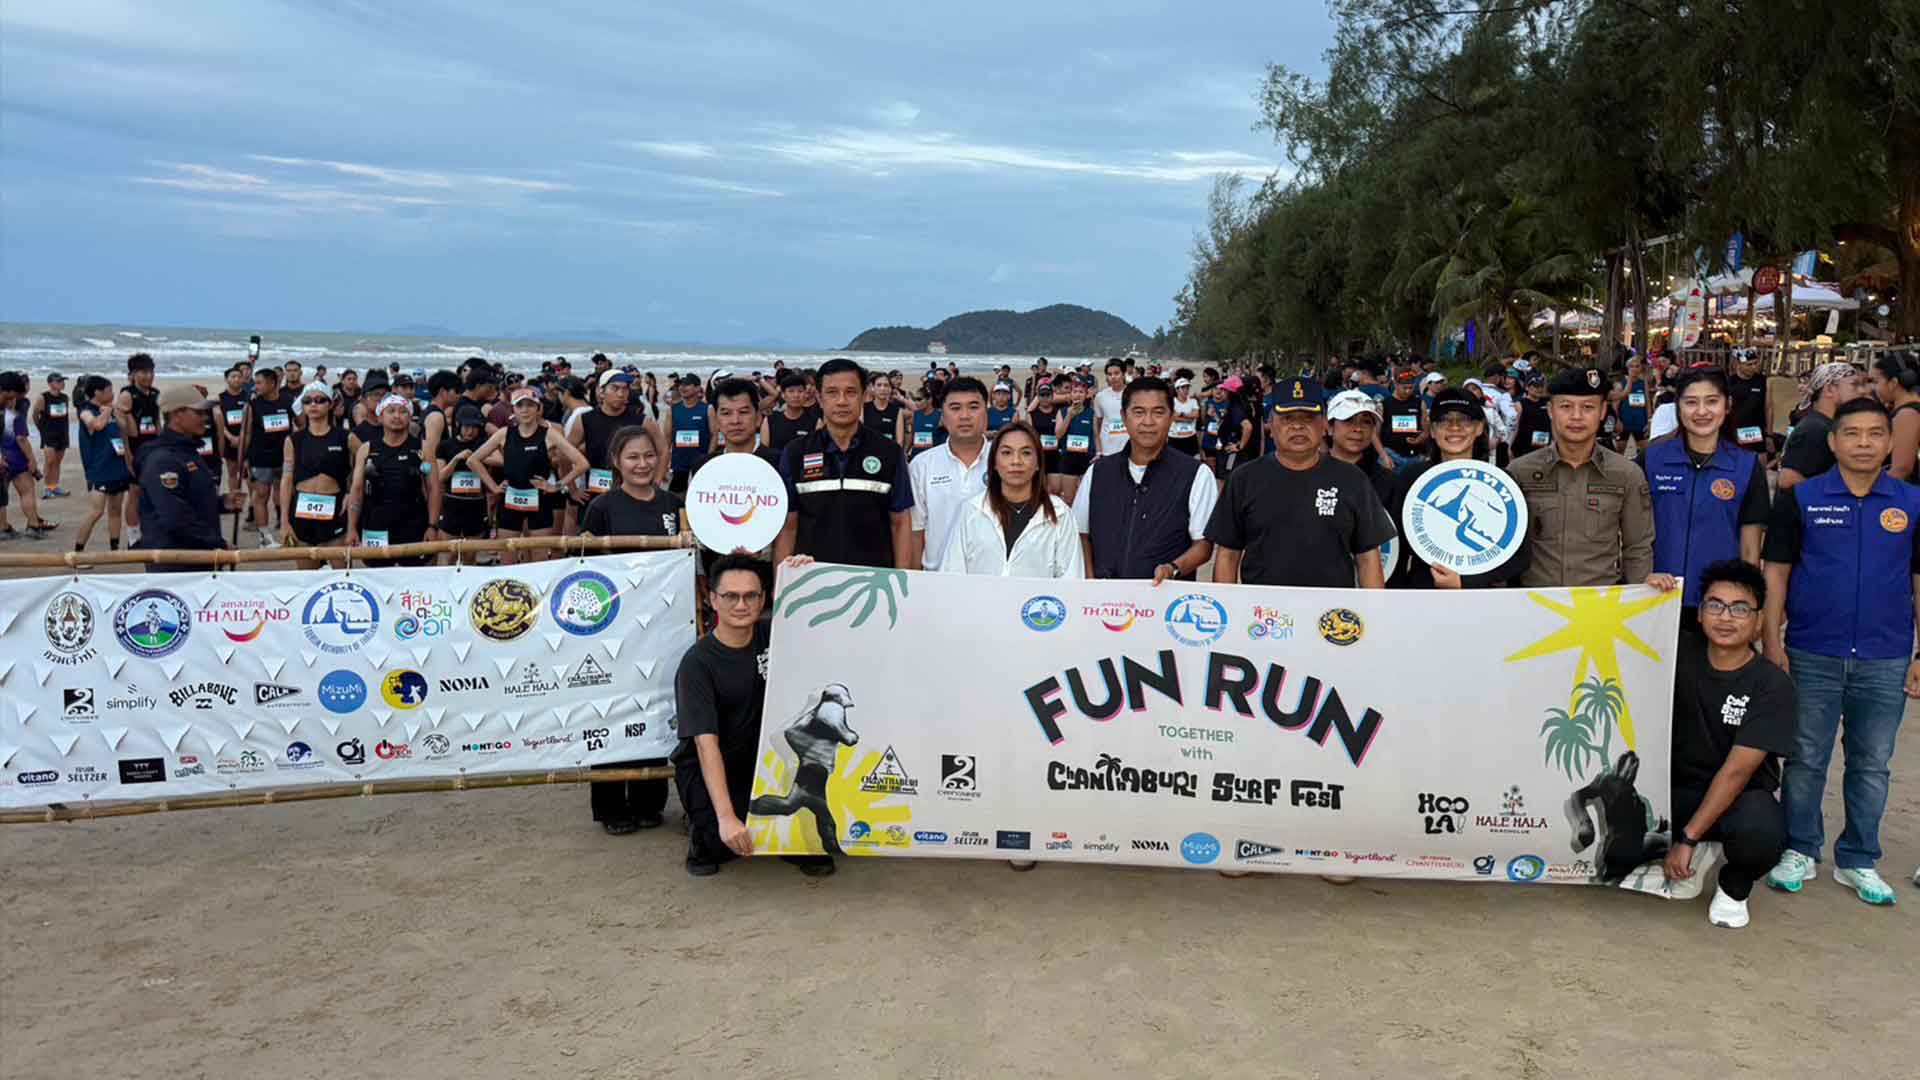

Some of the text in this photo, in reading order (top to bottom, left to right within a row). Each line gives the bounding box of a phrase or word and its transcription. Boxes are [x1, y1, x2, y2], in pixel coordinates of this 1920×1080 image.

[696, 491, 779, 507] THAILAND
[307, 503, 325, 513] 047
[220, 600, 265, 609] amazing
[195, 608, 291, 623] THAILAND
[1082, 606, 1155, 618] THAILAND
[439, 676, 491, 693] NOMA
[532, 680, 560, 691] HALA
[168, 682, 238, 708] BILLABONG
[106, 696, 158, 711] simplify
[1022, 649, 1384, 769] FUN RUN
[624, 722, 647, 738] NSP
[1158, 724, 1235, 744] TOGETHER
[1180, 746, 1214, 760] with
[20, 772, 55, 783] vitano
[67, 772, 108, 784] SELTZER
[1417, 792, 1470, 815] HOO
[1475, 815, 1549, 829] HALE HALA
[915, 833, 946, 843] vitano
[953, 836, 990, 847] SELTZER
[1131, 839, 1170, 851] NOMA
[1083, 842, 1120, 853] simplify
